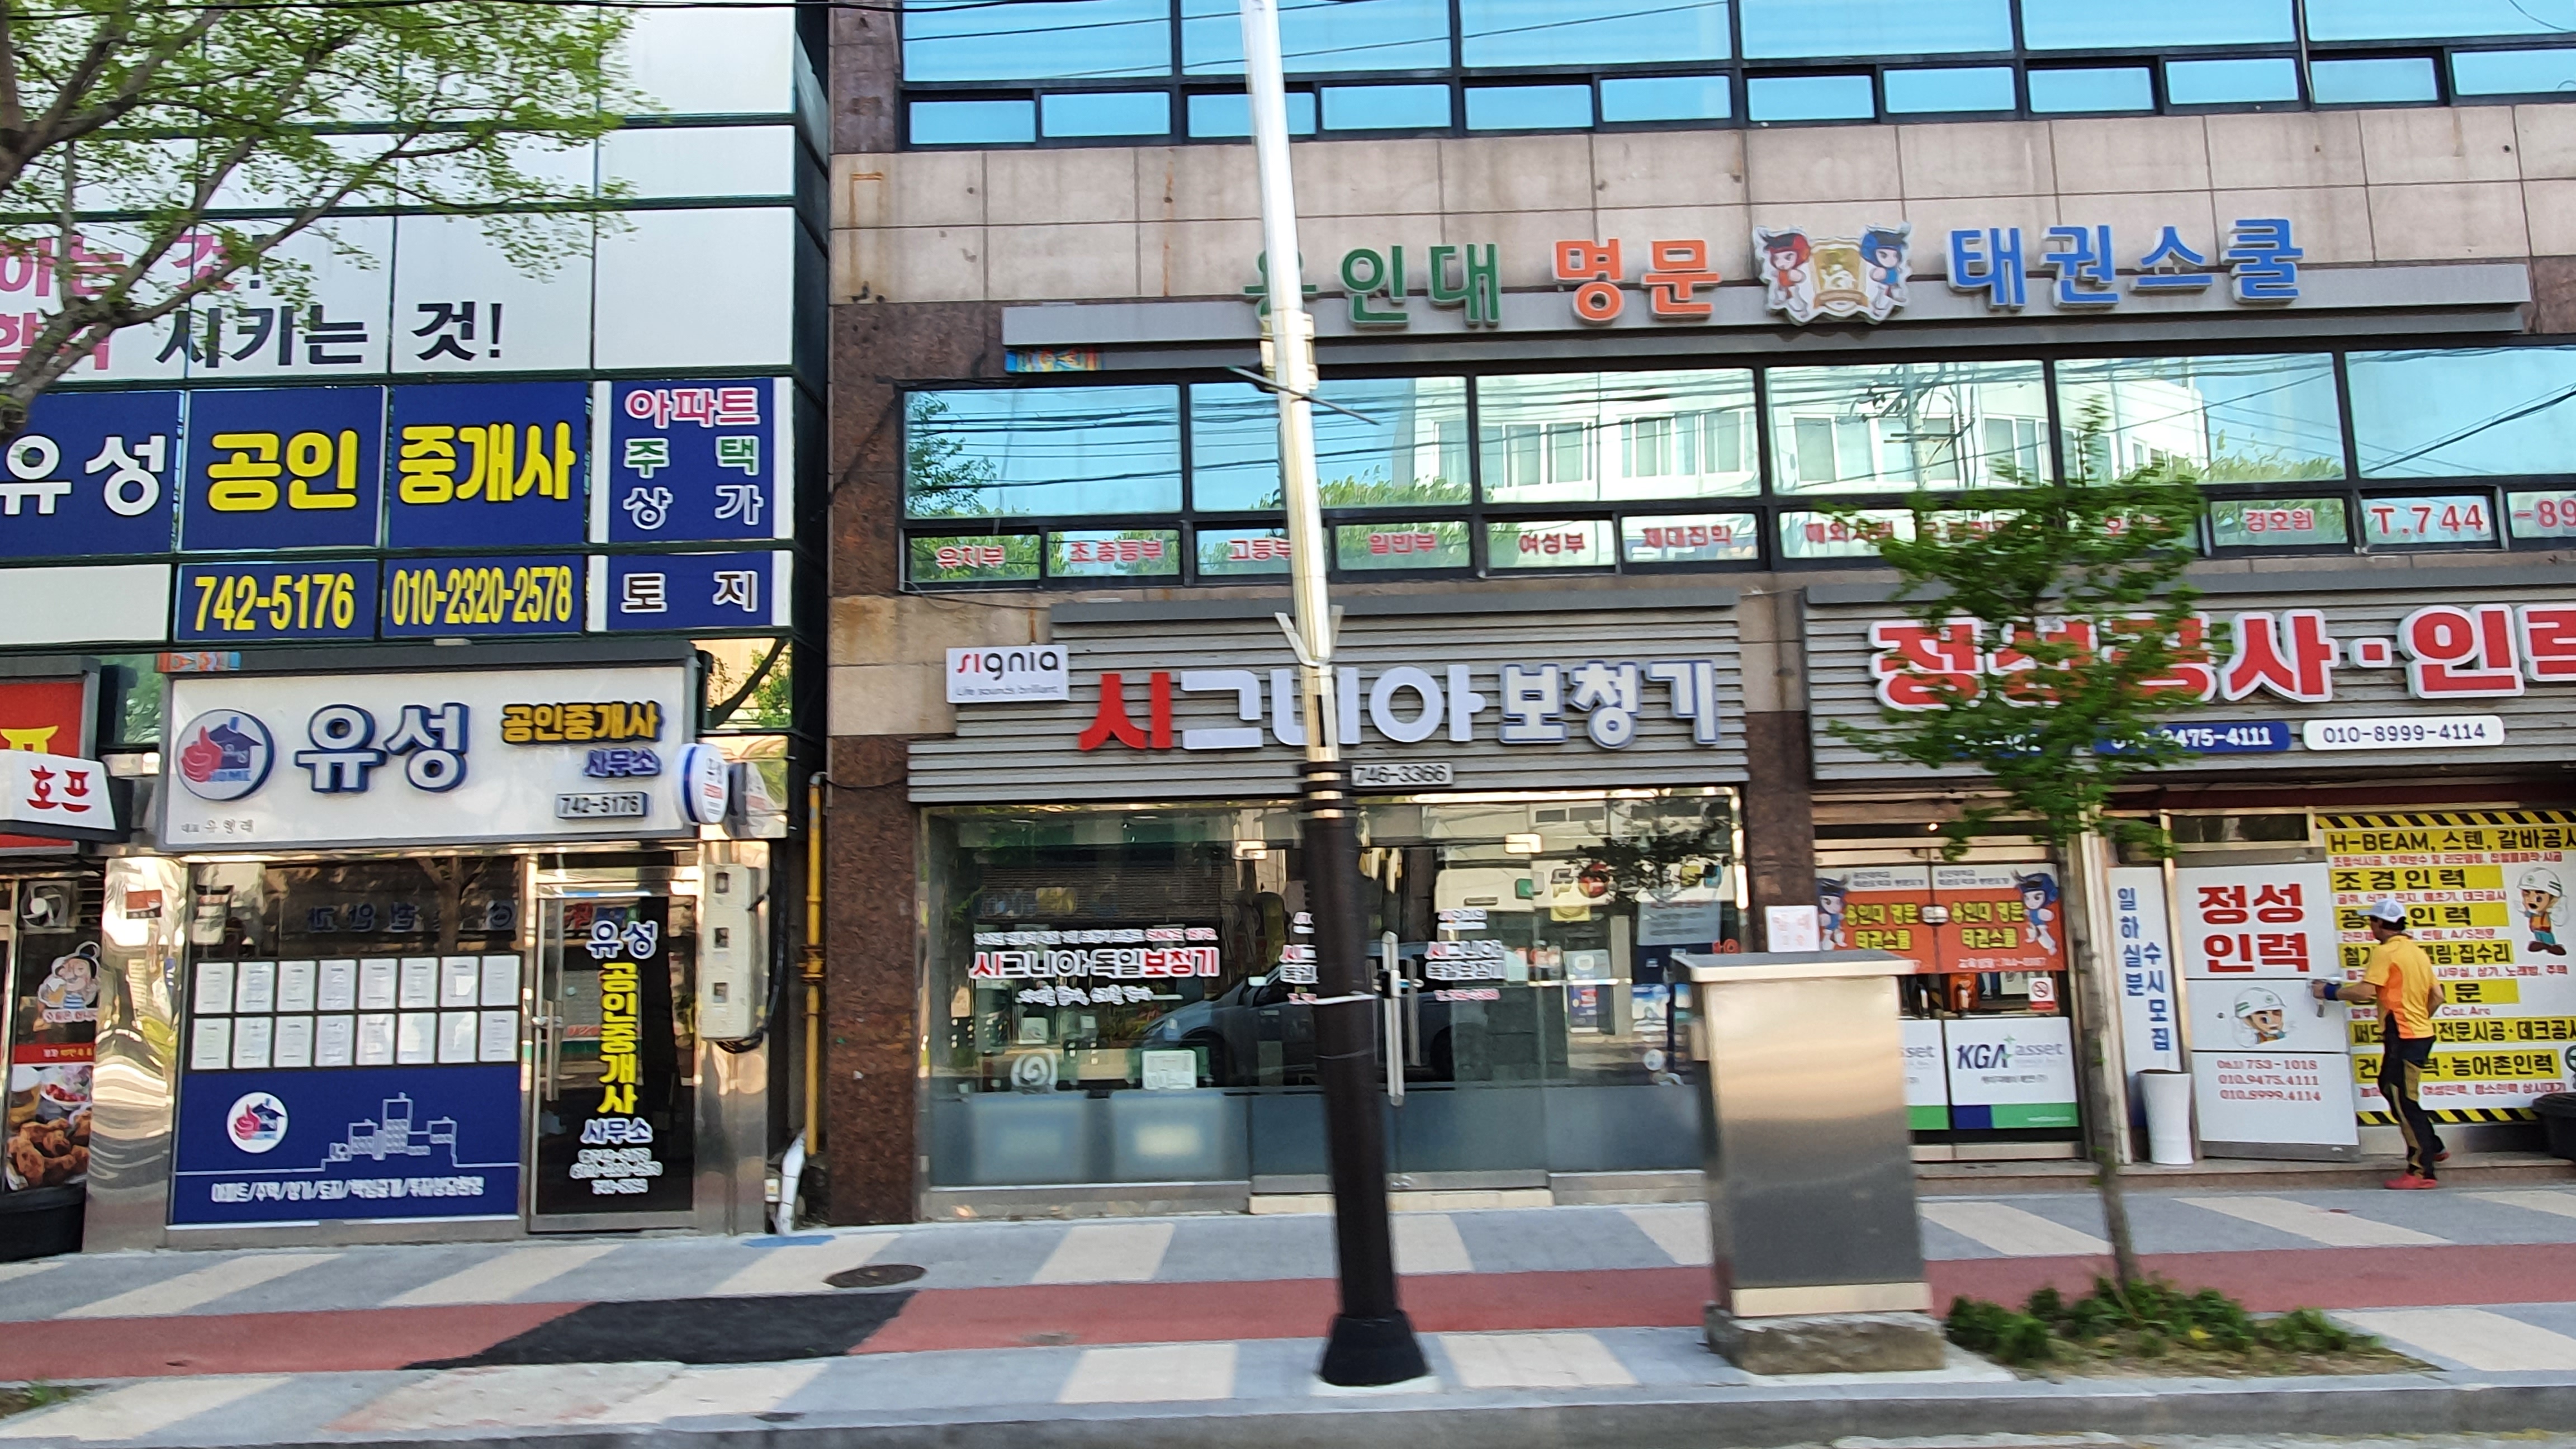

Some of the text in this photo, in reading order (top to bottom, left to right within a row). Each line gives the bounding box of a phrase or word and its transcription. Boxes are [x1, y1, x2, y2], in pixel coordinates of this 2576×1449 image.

[1243, 217, 2304, 326] 인대 명문 태권스쿨
[155, 304, 368, 369] 시키는
[411, 301, 502, 362] 것!
[624, 386, 761, 429] 아파트
[0, 422, 576, 516] 유성 공인 중개사
[2244, 508, 2314, 534] 경호원
[2370, 503, 2484, 536] T.744
[936, 544, 1005, 569] 유치부
[1228, 538, 1293, 562] 고등부
[1368, 531, 1438, 556] 일반부
[1518, 532, 1586, 555] 여성부
[193, 572, 355, 631] 742-5176
[392, 566, 573, 626] 010-2320-2578
[956, 651, 1060, 681] signia
[501, 700, 665, 745] 공인중개사
[1078, 659, 1721, 751] 시그니아 보청기
[294, 702, 470, 793] 유성
[2323, 722, 2487, 744] 010-8999-4114
[583, 747, 662, 778] 사무소
[1353, 765, 1447, 783] 746-3366
[26, 764, 92, 812] 호프
[561, 795, 640, 815] 742-5176
[2330, 831, 2436, 853] H-BEAM,
[2441, 830, 2493, 850] 스텐,
[2334, 868, 2466, 891] 조경인력
[2197, 883, 2306, 925] 정성
[586, 920, 659, 959] 유성
[2203, 932, 2311, 973] 인력
[2143, 941, 2171, 1052] 수시모집
[596, 962, 639, 1115] 공인중개사
[1955, 1044, 2010, 1069] KGA
[2014, 1042, 2066, 1056] asset
[580, 1117, 654, 1144] 사무소
